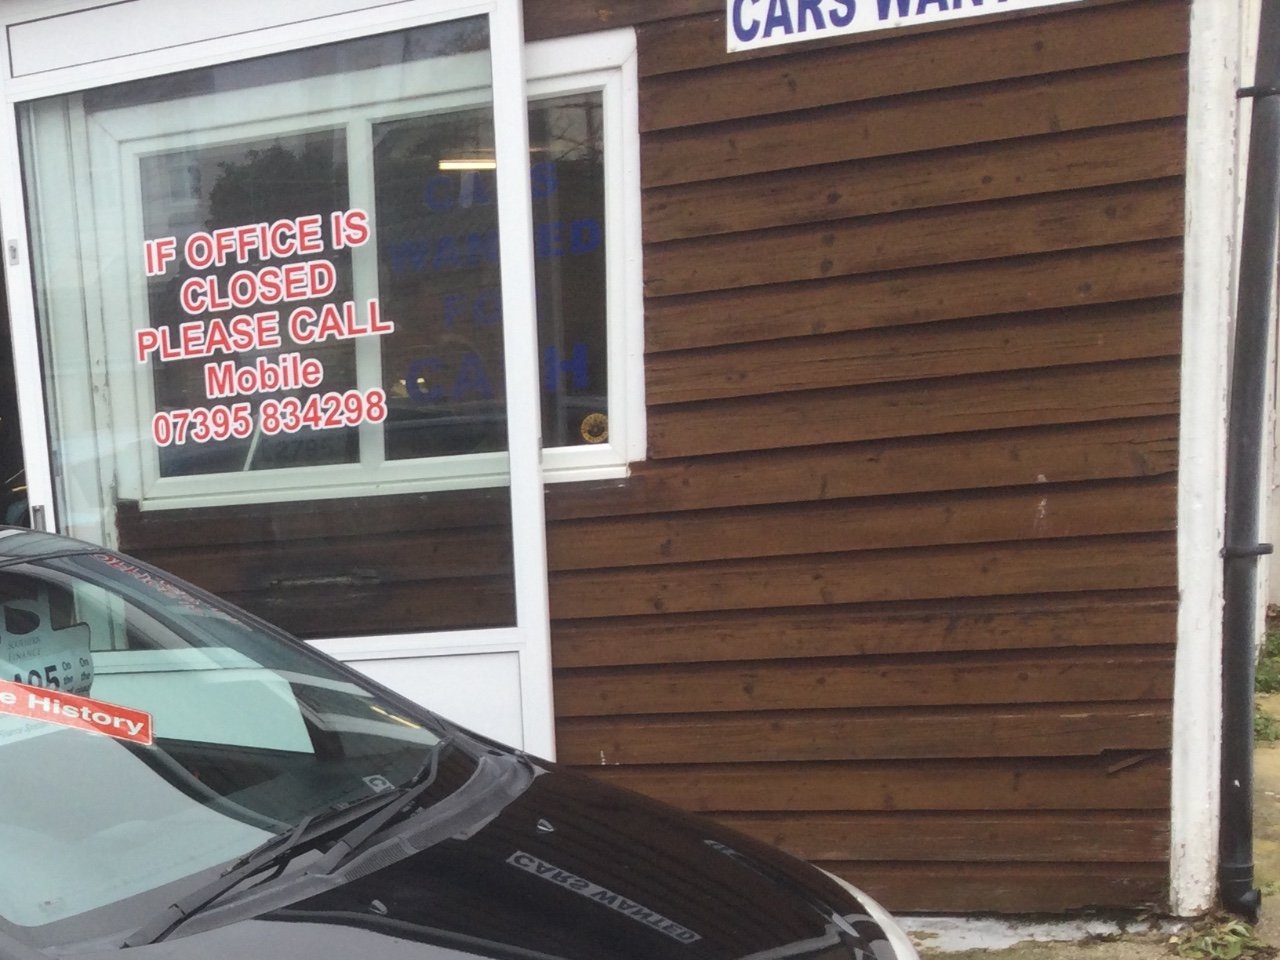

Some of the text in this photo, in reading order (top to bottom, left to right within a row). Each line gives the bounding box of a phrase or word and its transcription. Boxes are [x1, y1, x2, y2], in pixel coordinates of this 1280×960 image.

[732, 0, 856, 42] CARS
[423, 163, 559, 211] CAS
[144, 208, 370, 277] IF OFFICE IS
[387, 219, 601, 274] WANED
[180, 259, 337, 315] CLOSED
[135, 298, 395, 364] PLEASE CALL
[203, 352, 325, 399] Mobile
[405, 343, 589, 401] CAH
[152, 388, 388, 447] 07395 834298
[28, 693, 144, 737] History
